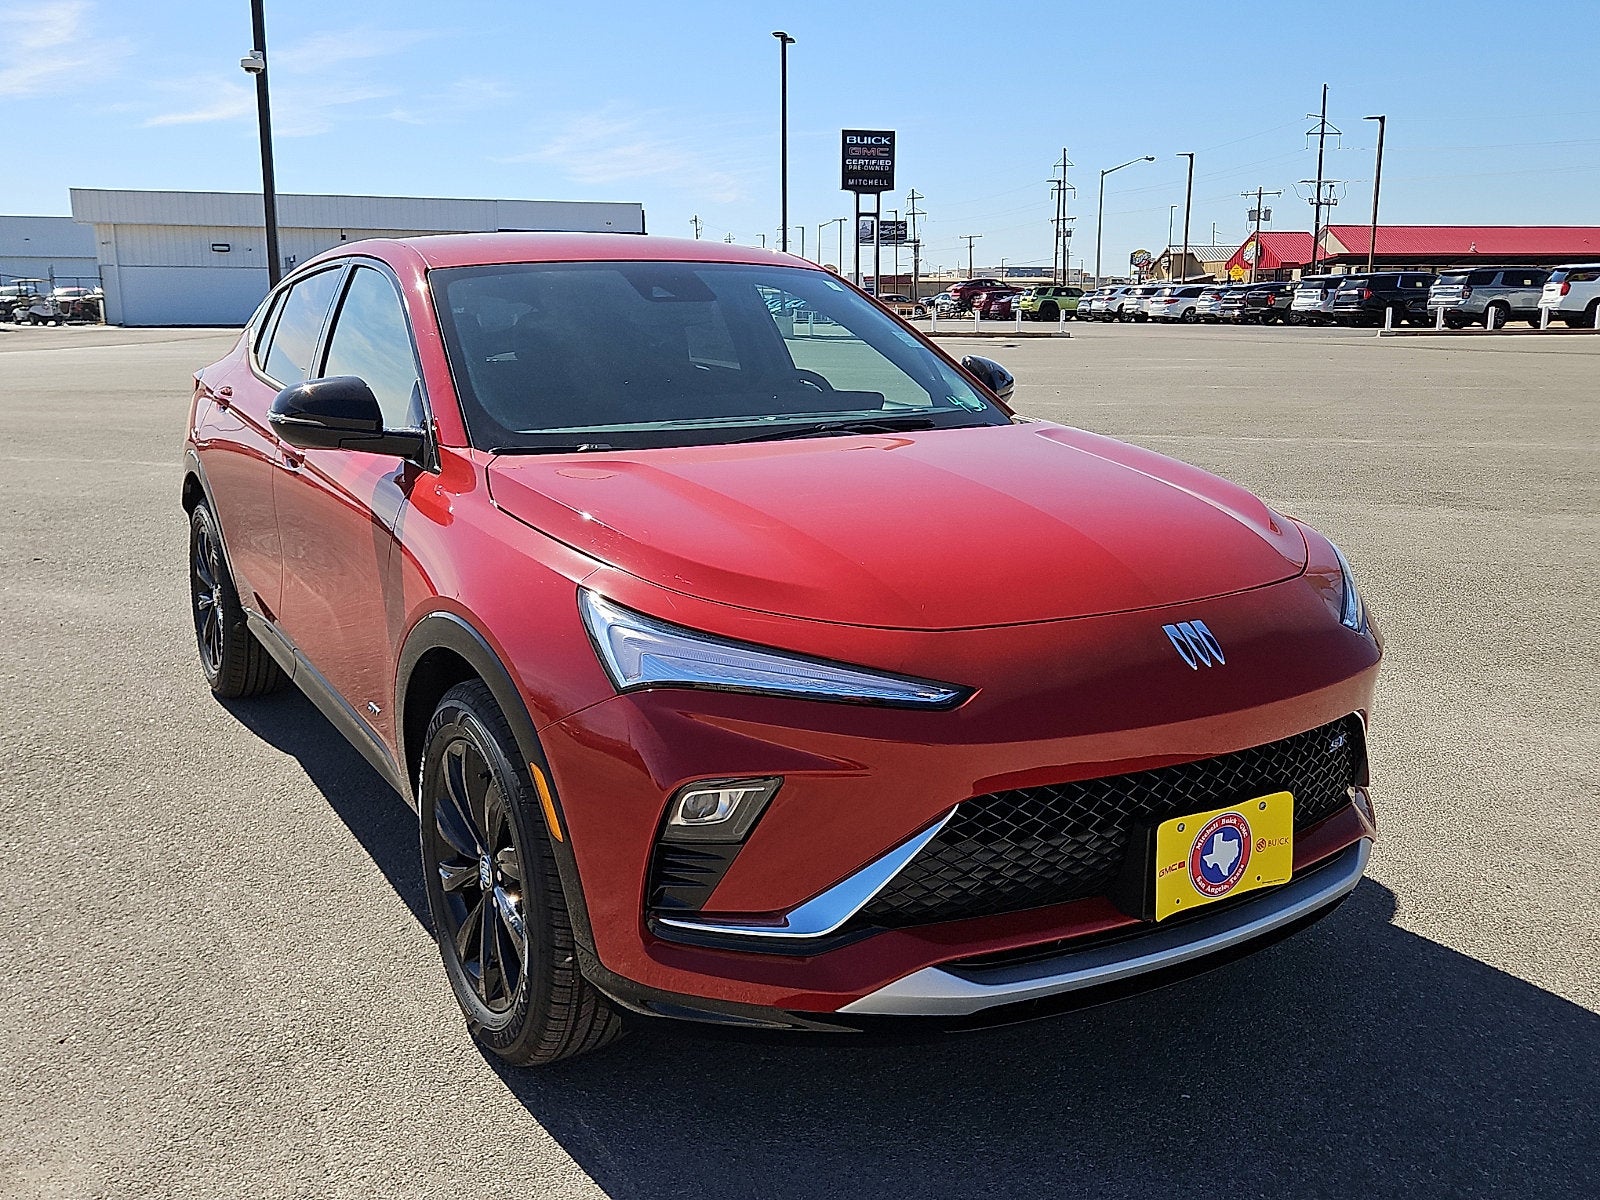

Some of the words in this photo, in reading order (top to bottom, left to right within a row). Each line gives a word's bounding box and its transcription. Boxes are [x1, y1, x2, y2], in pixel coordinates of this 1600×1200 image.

[847, 136, 891, 144] BUICK
[849, 147, 889, 156] GMC
[1196, 821, 1219, 850] Mitchell
[1221, 817, 1238, 825] Buick
[1267, 837, 1289, 847] BUICK
[1158, 863, 1178, 878] GMC
[1196, 875, 1206, 891] San
